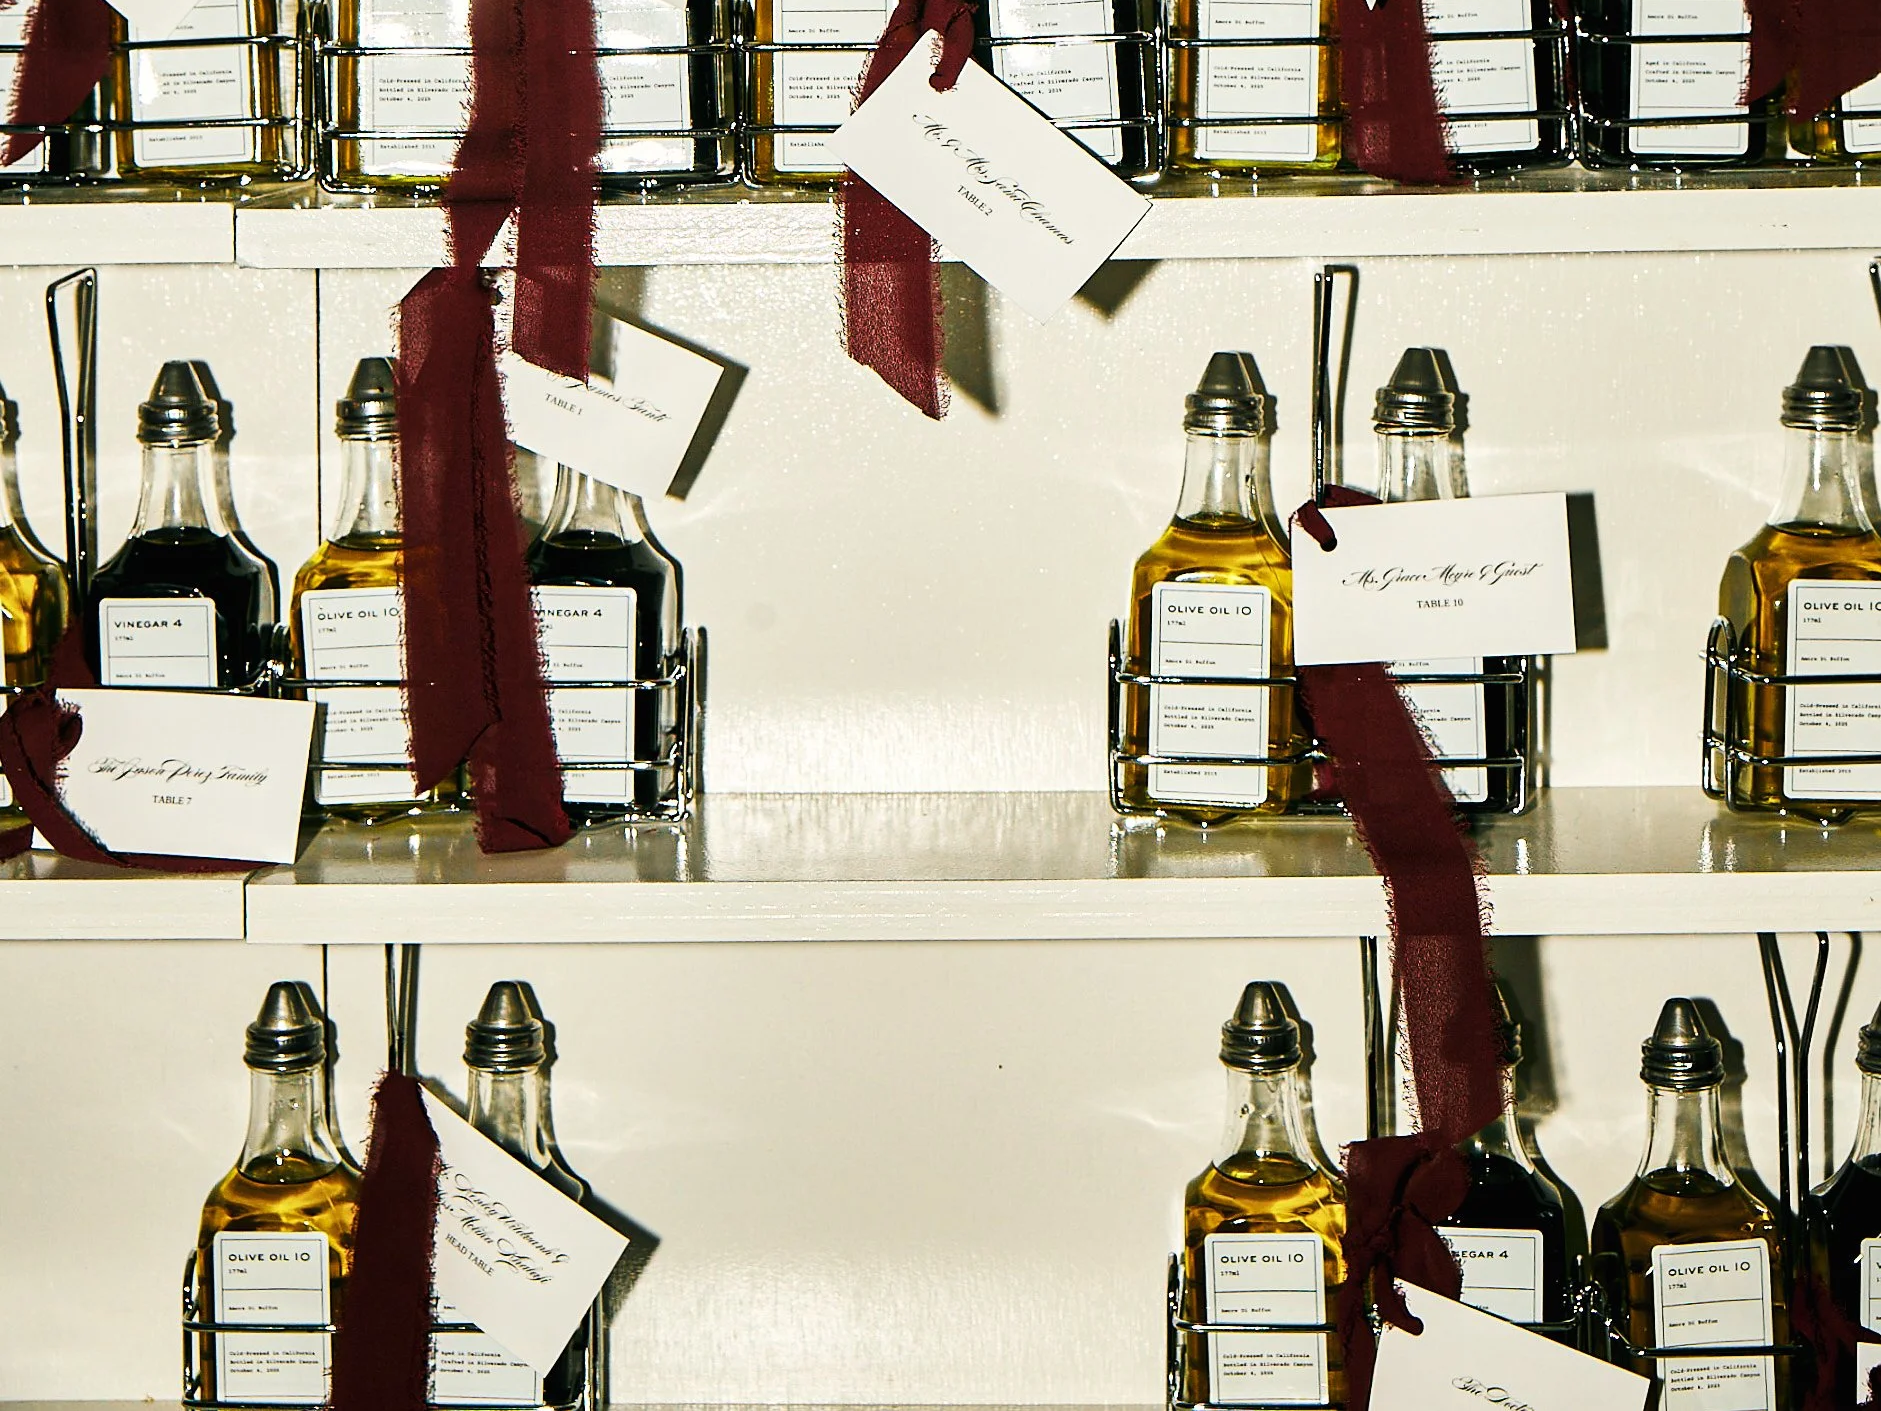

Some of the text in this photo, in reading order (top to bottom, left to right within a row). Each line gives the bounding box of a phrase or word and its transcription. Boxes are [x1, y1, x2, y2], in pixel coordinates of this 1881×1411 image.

[912, 114, 948, 140] Mr.
[941, 138, 959, 147] &
[954, 147, 989, 184] Mrs.
[957, 185, 993, 217] TABLE 2
[545, 393, 576, 413] TABLE
[1342, 569, 1378, 588] Ms.
[1379, 568, 1424, 591] Grace
[1479, 564, 1495, 581] &
[1416, 598, 1464, 609] TABLE 10
[1803, 602, 1839, 610] OLIVE
[1844, 602, 1864, 611] OIL
[317, 607, 399, 621] OLIVE OIL 10
[593, 609, 602, 617] 4
[1167, 605, 1252, 616] OLIVE OIL 10
[114, 619, 182, 628] VINEGAR 4
[216, 765, 268, 785] Family
[153, 795, 184, 805] TABLE
[228, 1252, 311, 1262] OLIVE OIL 10
[445, 1233, 494, 1277] HEAD TABLE
[551, 1253, 568, 1264] &
[1220, 1253, 1304, 1264] OLIVE OIL 10
[1499, 1250, 1509, 1259] 4
[1668, 1261, 1751, 1277] OLIVE OIL 10
